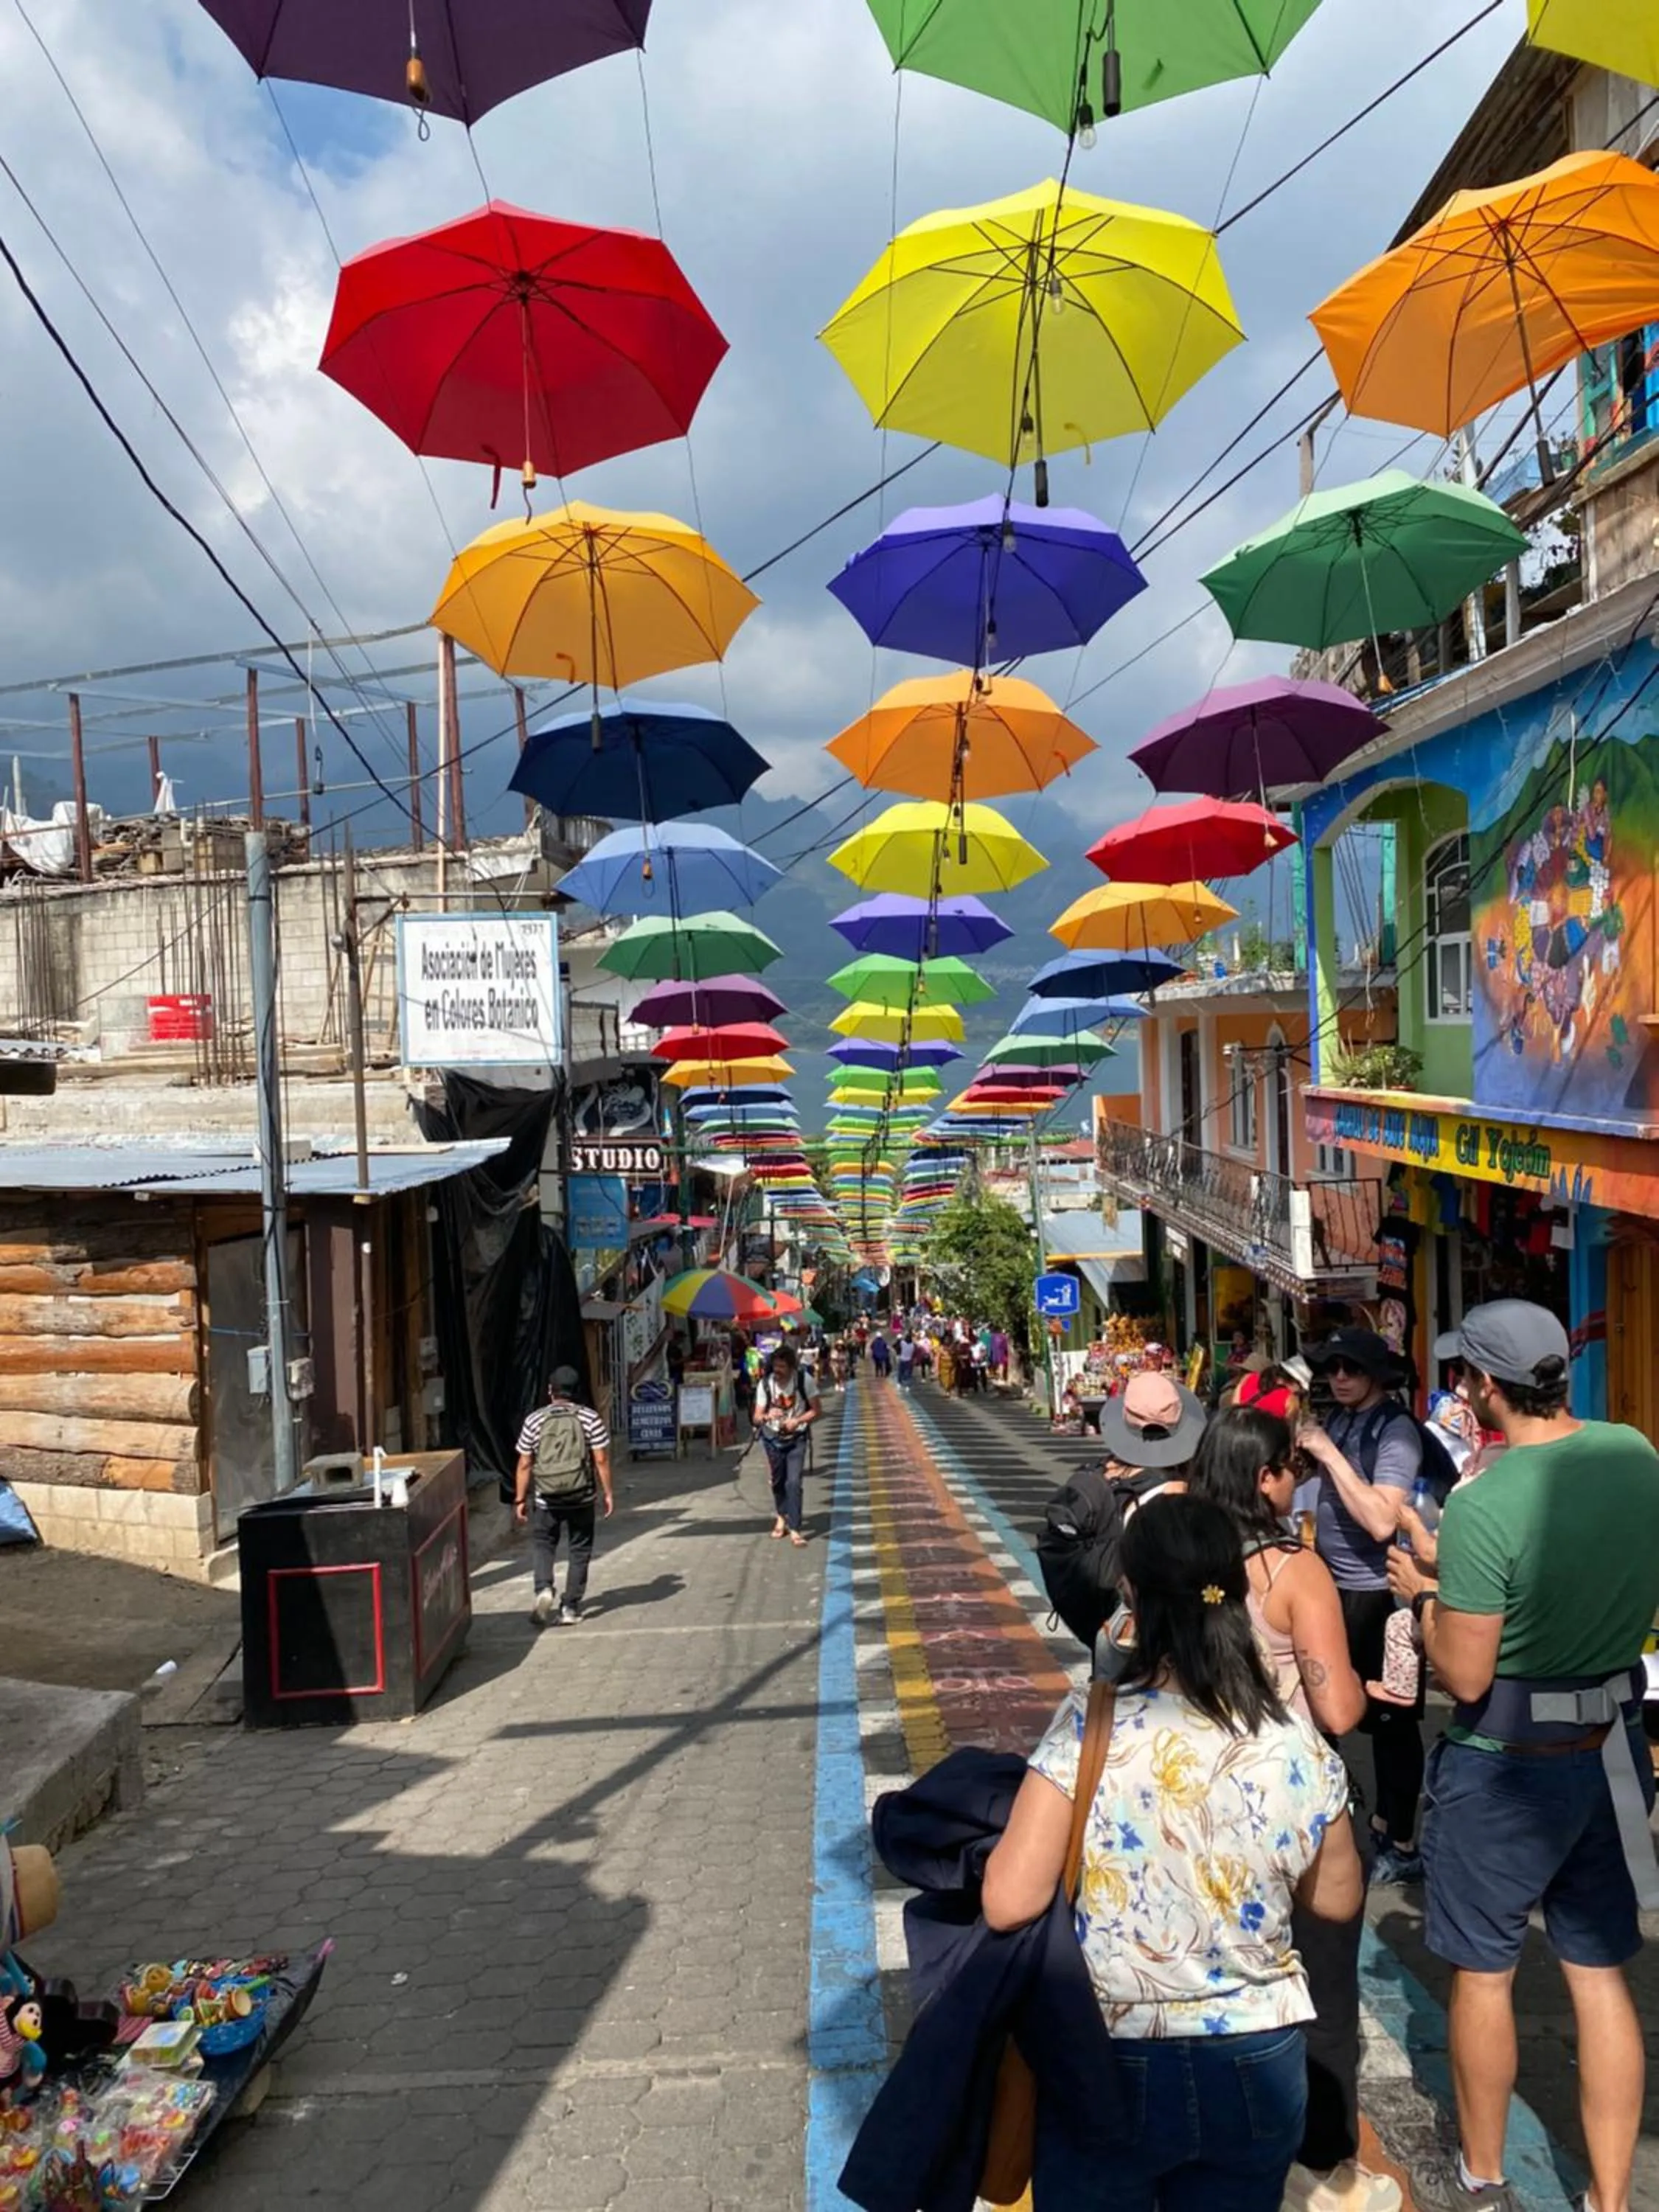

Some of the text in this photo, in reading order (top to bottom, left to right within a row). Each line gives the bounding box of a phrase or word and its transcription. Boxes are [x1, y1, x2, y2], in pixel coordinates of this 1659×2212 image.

[480, 941, 493, 980] de
[495, 941, 537, 991] Mujeres
[425, 998, 439, 1030] en
[442, 989, 485, 1030] Colores
[571, 1147, 660, 1171] STUDIO
